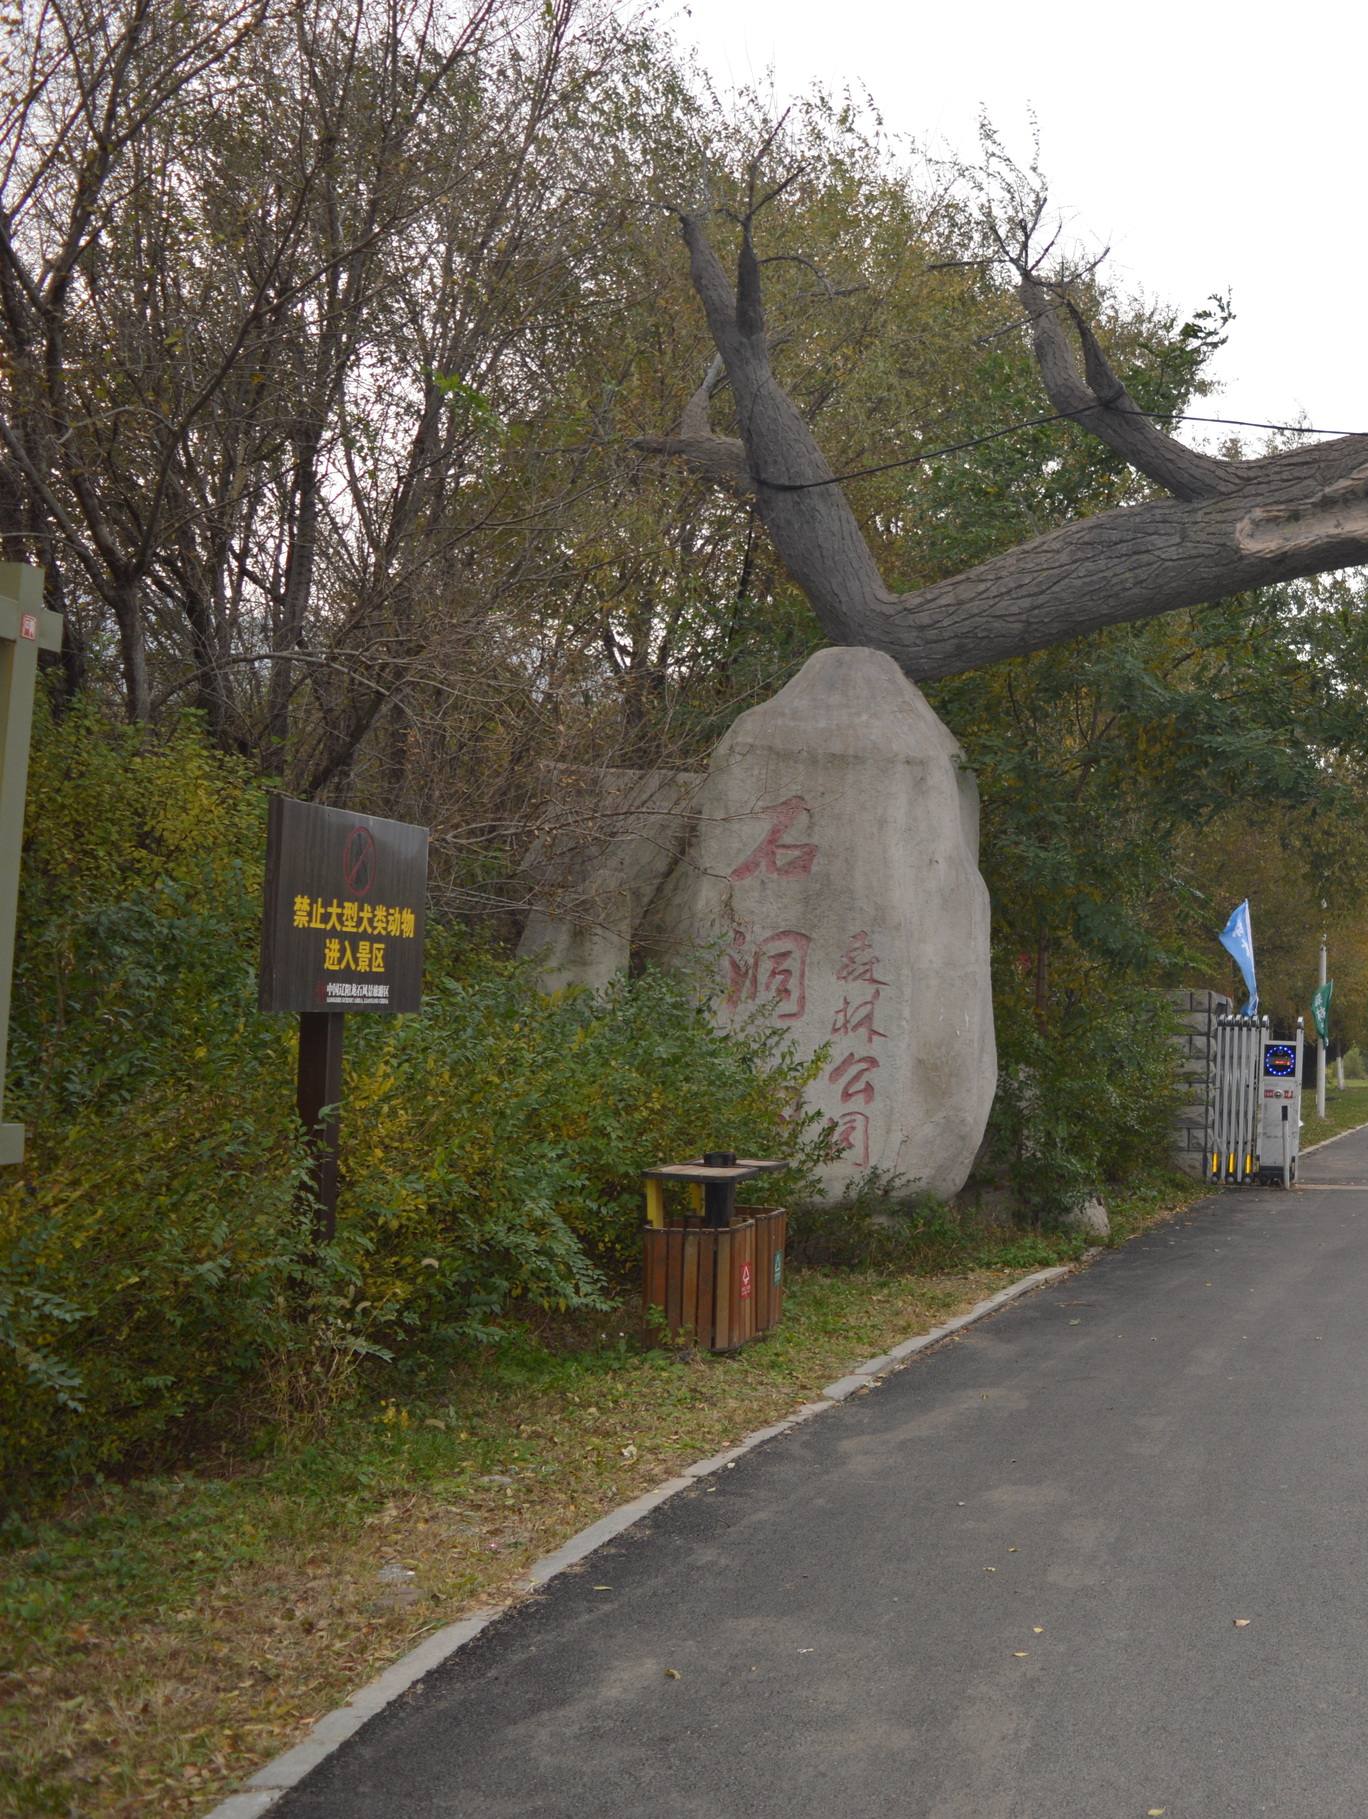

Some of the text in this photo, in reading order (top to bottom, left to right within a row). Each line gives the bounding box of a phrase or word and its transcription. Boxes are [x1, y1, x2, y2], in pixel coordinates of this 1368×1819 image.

[293, 895, 415, 938] 禁止大型犬类动物
[324, 938, 386, 973] 进入景区
